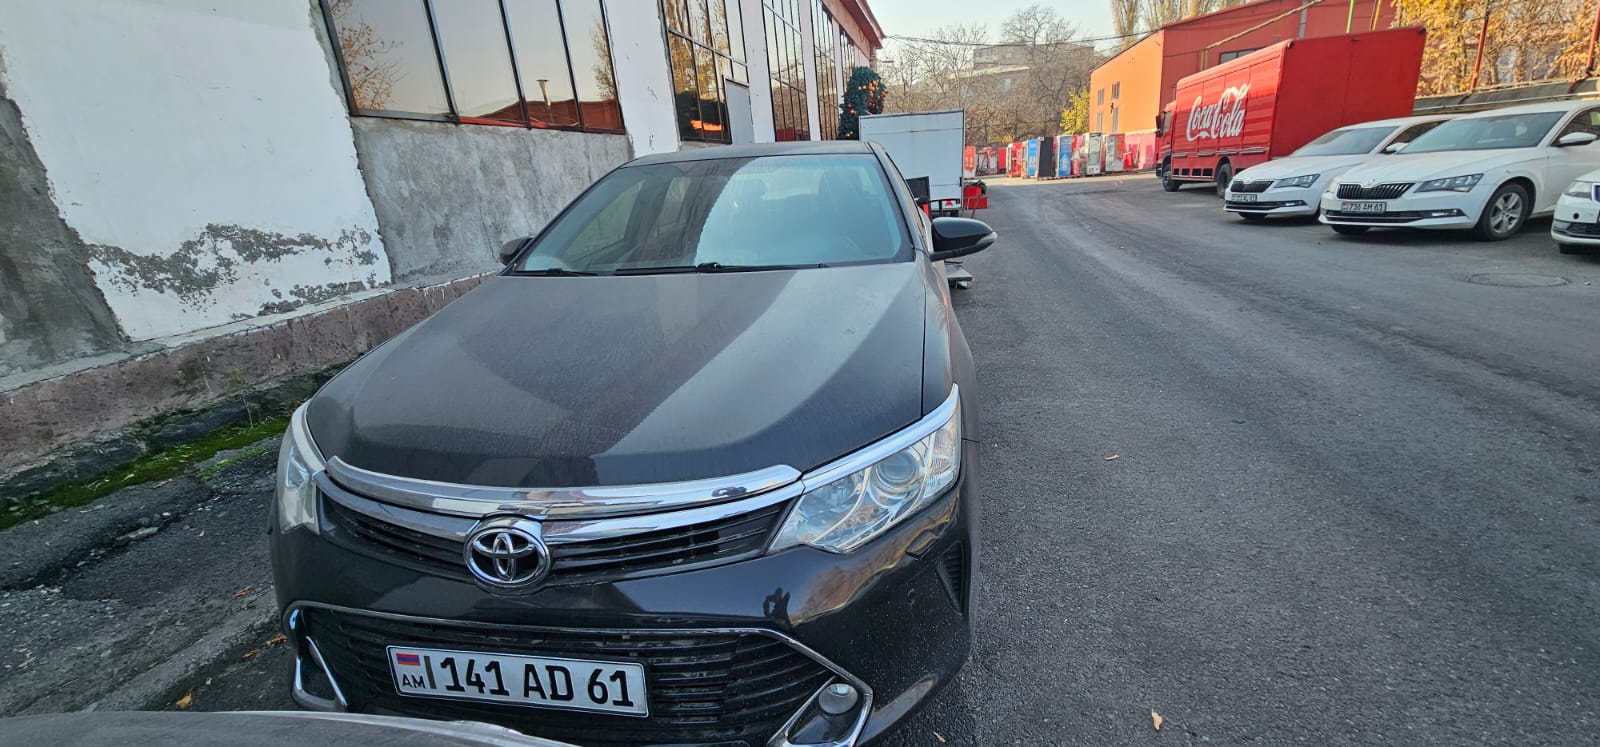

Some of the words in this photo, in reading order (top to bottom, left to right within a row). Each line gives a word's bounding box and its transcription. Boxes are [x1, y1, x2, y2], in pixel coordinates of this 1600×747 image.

[402, 673, 426, 689] AM
[440, 657, 510, 696] 141
[523, 663, 574, 701] AD
[588, 669, 634, 707] 61
